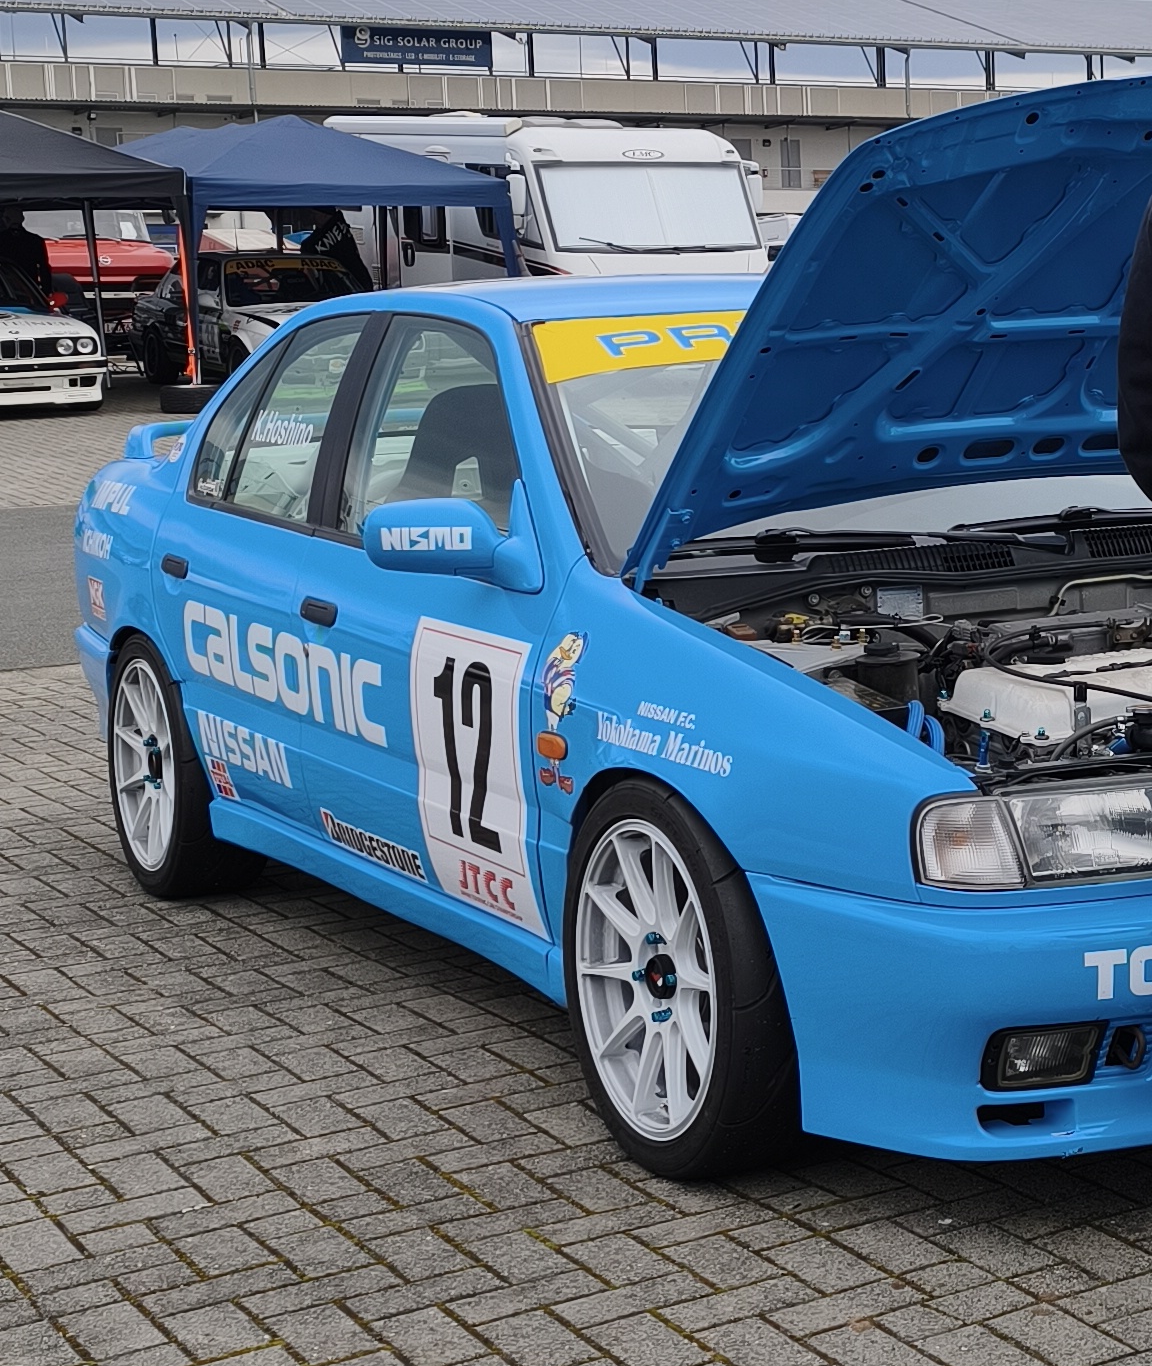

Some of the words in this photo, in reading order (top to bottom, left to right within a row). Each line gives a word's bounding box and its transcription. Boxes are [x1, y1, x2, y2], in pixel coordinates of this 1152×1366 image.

[374, 36, 393, 46] SIG
[397, 37, 437, 47] SOLAR
[440, 38, 483, 49] GROUP
[632, 150, 656, 158] LMC
[236, 259, 275, 270] ADAC
[301, 259, 338, 269] ADAC
[596, 322, 737, 357] PR
[251, 409, 314, 447] K.Hoshino
[91, 480, 137, 516] IMPUL
[82, 528, 114, 560] ICHIKOH
[380, 526, 473, 550] NISMO
[636, 700, 679, 725] NISSAN
[677, 710, 696, 730] F.C.
[197, 709, 294, 789] NISSAN
[433, 656, 503, 854] 12
[597, 710, 662, 756] Yokohama
[660, 730, 733, 778] Marinos
[322, 810, 426, 881] BRIDGESTONE
[458, 859, 516, 911] JTCC
